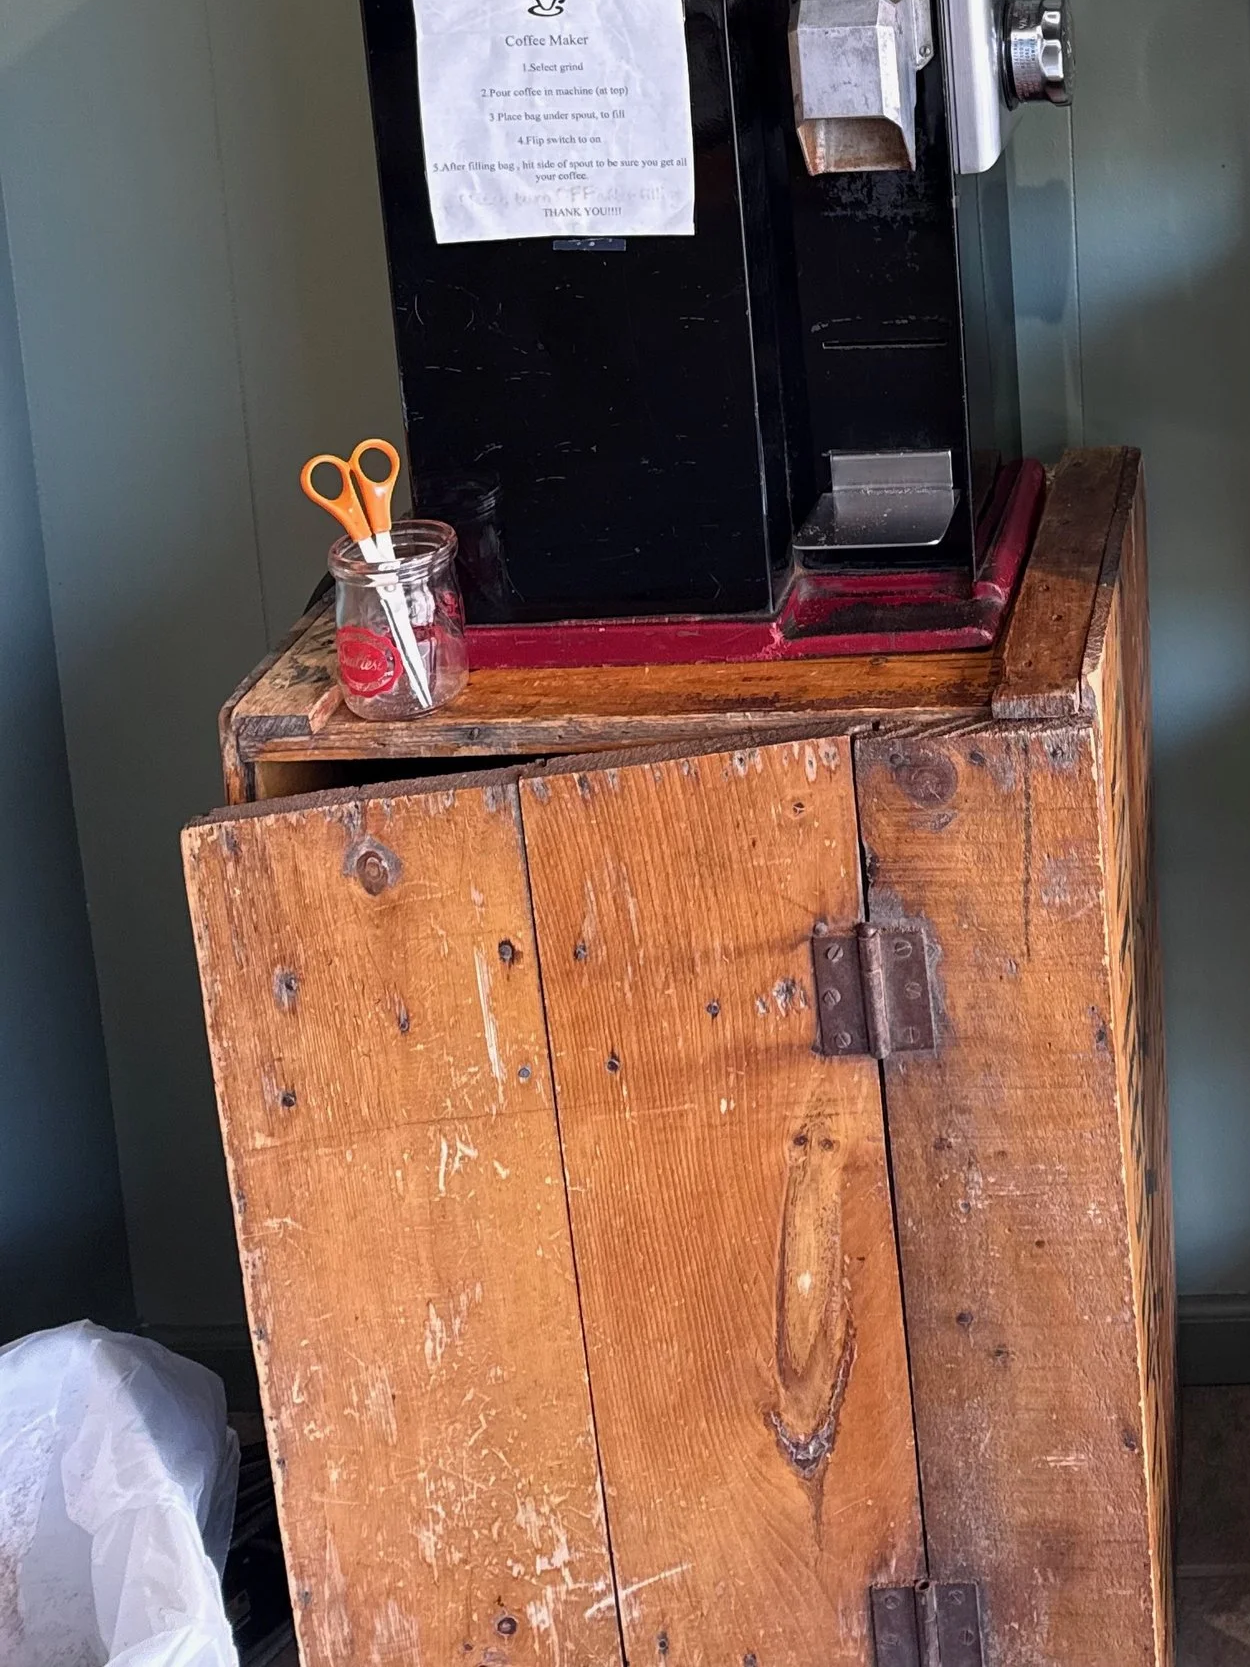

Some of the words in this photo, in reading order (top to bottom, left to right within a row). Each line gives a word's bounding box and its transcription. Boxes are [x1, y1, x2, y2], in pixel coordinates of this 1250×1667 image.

[505, 35, 546, 47] Coffee
[549, 35, 588, 46] Maker
[560, 62, 583, 74] grind
[513, 88, 542, 97] coffee
[545, 88, 553, 96] in
[555, 87, 593, 96] machine
[595, 86, 607, 97] (at
[610, 86, 629, 97] top)
[525, 111, 541, 123] bag
[543, 111, 568, 120] under
[571, 111, 599, 121] spout,
[601, 111, 610, 119] to
[612, 110, 625, 118] fill
[547, 135, 576, 145] switch
[578, 136, 587, 144] to
[468, 161, 496, 172] filling
[522, 160, 534, 170] hit
[537, 159, 555, 169] side
[558, 159, 568, 168] of
[570, 159, 593, 170] spout
[596, 159, 605, 167] to
[607, 159, 618, 167] be
[620, 159, 639, 167] sure
[642, 159, 658, 169] you
[660, 158, 674, 169] get
[677, 158, 687, 167] all
[535, 173, 555, 182] your
[544, 208, 581, 217] THANK
